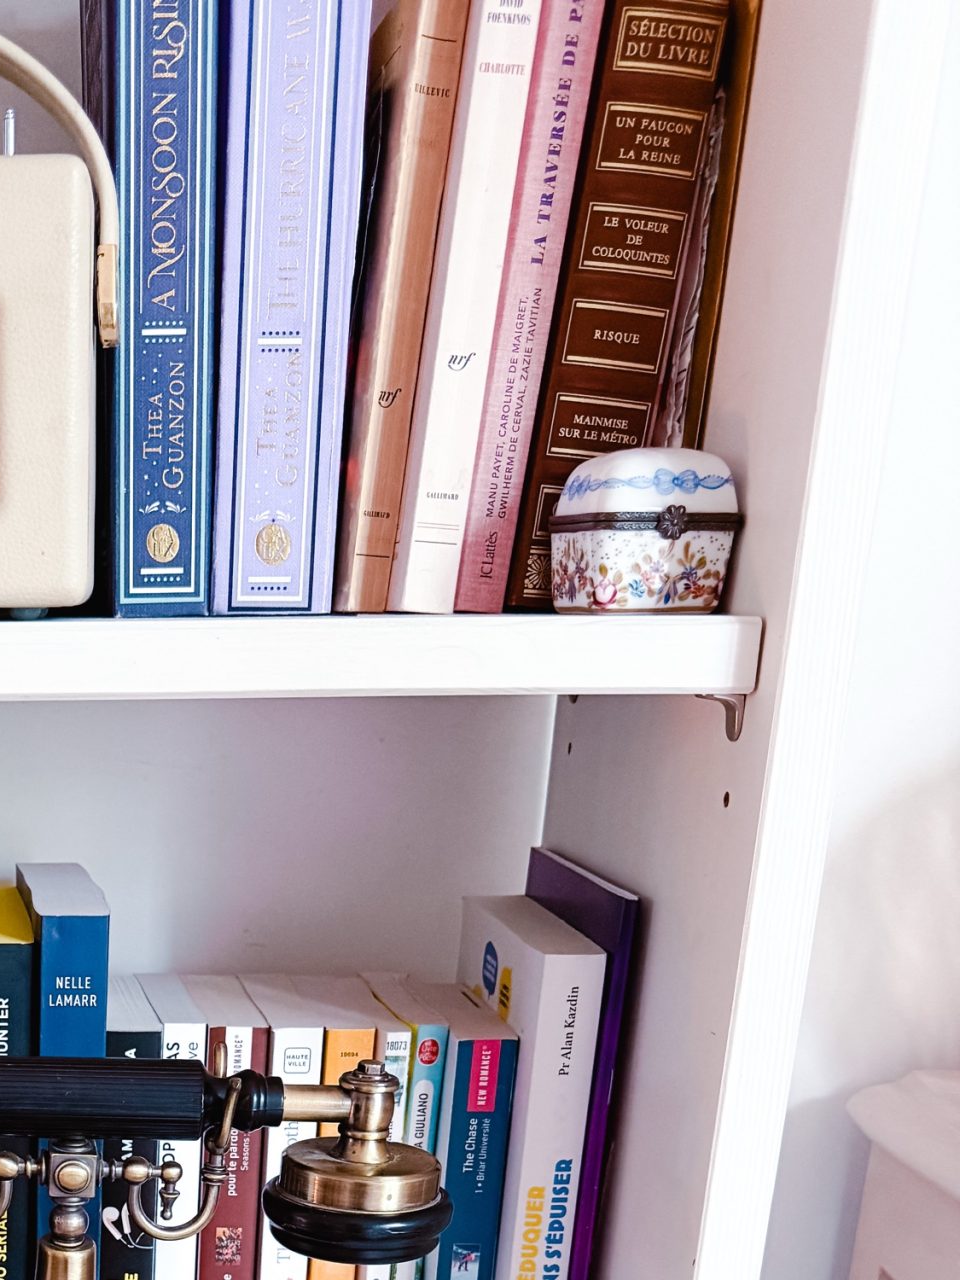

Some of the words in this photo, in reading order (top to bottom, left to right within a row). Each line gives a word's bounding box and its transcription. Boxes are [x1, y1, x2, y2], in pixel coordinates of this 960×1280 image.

[486, 11, 531, 25] FOENKINOS
[628, 18, 715, 44] SÉLECTION
[561, 33, 579, 67] DE
[625, 41, 652, 58] DU
[657, 44, 710, 65] LIVRE
[478, 61, 526, 76] CHARLOTTE
[615, 116, 637, 128] UN
[640, 119, 693, 134] FAUCON
[536, 77, 573, 225] TRAVERSÉE
[634, 134, 670, 148] POUR
[618, 148, 635, 160] LA
[641, 150, 681, 165] REINE
[147, 91, 186, 289] MONSOON
[603, 216, 619, 228] LE
[625, 218, 669, 234] VOLEUR
[530, 234, 548, 266] LA
[626, 234, 643, 246] DE
[592, 246, 670, 265] COLOQUINTES
[151, 288, 175, 311] A
[267, 258, 300, 320] THE
[525, 288, 542, 342] TAVITIAN
[593, 329, 640, 344] RISQUE
[448, 352, 476, 371] nrf
[521, 346, 533, 382] ZAZIE
[378, 388, 402, 408] nrf
[143, 392, 163, 459] THEA
[162, 361, 185, 489] GUANZON
[256, 387, 277, 457] THEA
[275, 351, 302, 488] GUANZON
[573, 414, 628, 429] MAINMISE
[486, 481, 498, 518] MANU
[498, 377, 514, 438] CAROLINE
[508, 356, 518, 374] DE
[508, 437, 518, 453] DE
[558, 427, 580, 438] SUR
[583, 430, 598, 441] LE
[600, 430, 638, 446] MÉTRO
[499, 456, 515, 519] GWILHERM
[56, 977, 92, 989] NELLE
[49, 994, 97, 1007] LAMARR
[563, 985, 580, 1024] Kazdin
[560, 1026, 574, 1061] Alan
[558, 1062, 570, 1076] Pr
[477, 1089, 487, 1106] NEW
[415, 1093, 429, 1139] GIULIANO
[228, 1128, 238, 1160] pardo
[464, 1118, 478, 1151] Chase
[478, 1118, 491, 1158] Université
[241, 1138, 250, 1171] Seasons
[463, 1152, 474, 1173] The
[228, 1162, 238, 1174] te
[476, 1158, 486, 1181] Briar
[227, 1175, 238, 1197] pour
